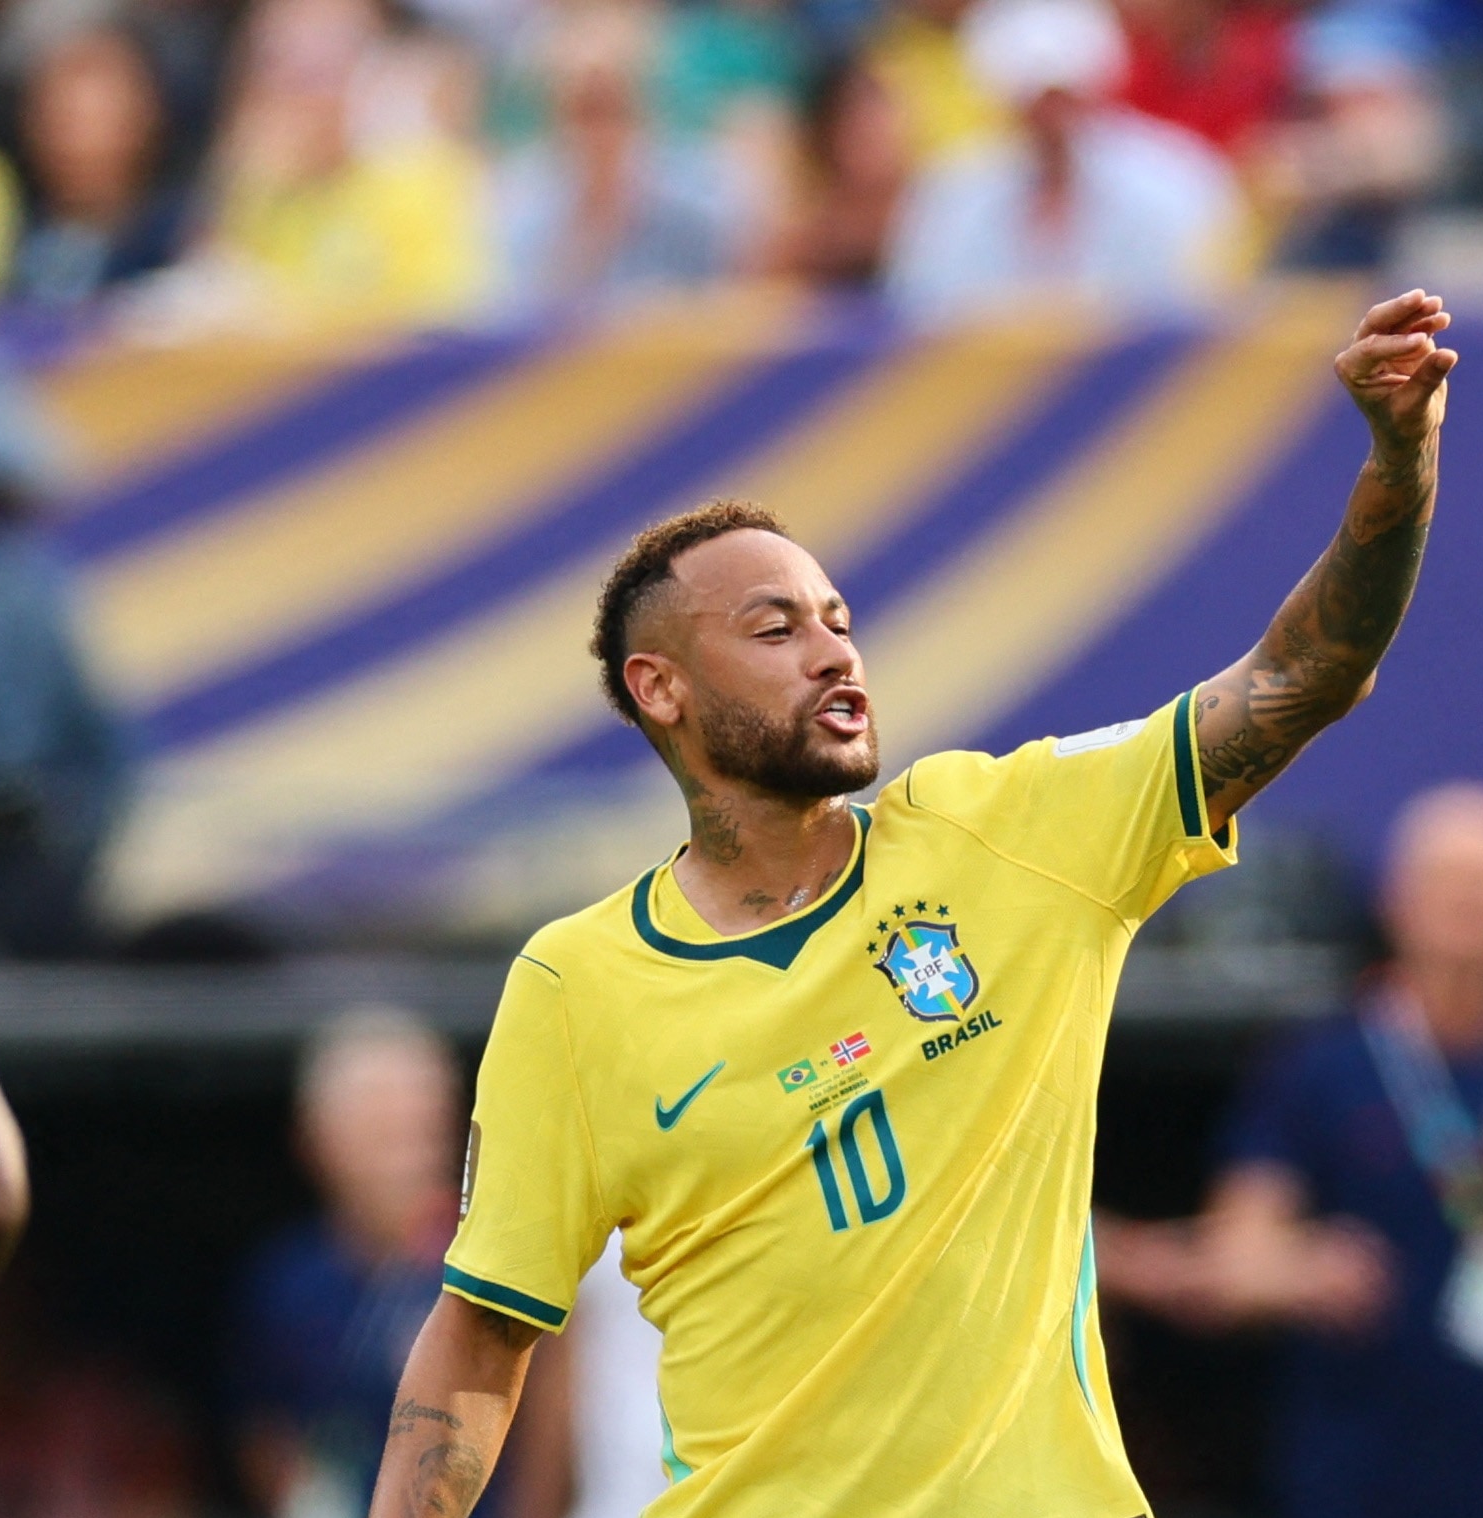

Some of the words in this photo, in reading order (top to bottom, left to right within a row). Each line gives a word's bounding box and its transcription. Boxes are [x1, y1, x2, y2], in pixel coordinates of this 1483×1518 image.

[914, 959, 944, 982] CBF
[920, 1010, 1003, 1062] BRASIL
[804, 1087, 907, 1233] 10
